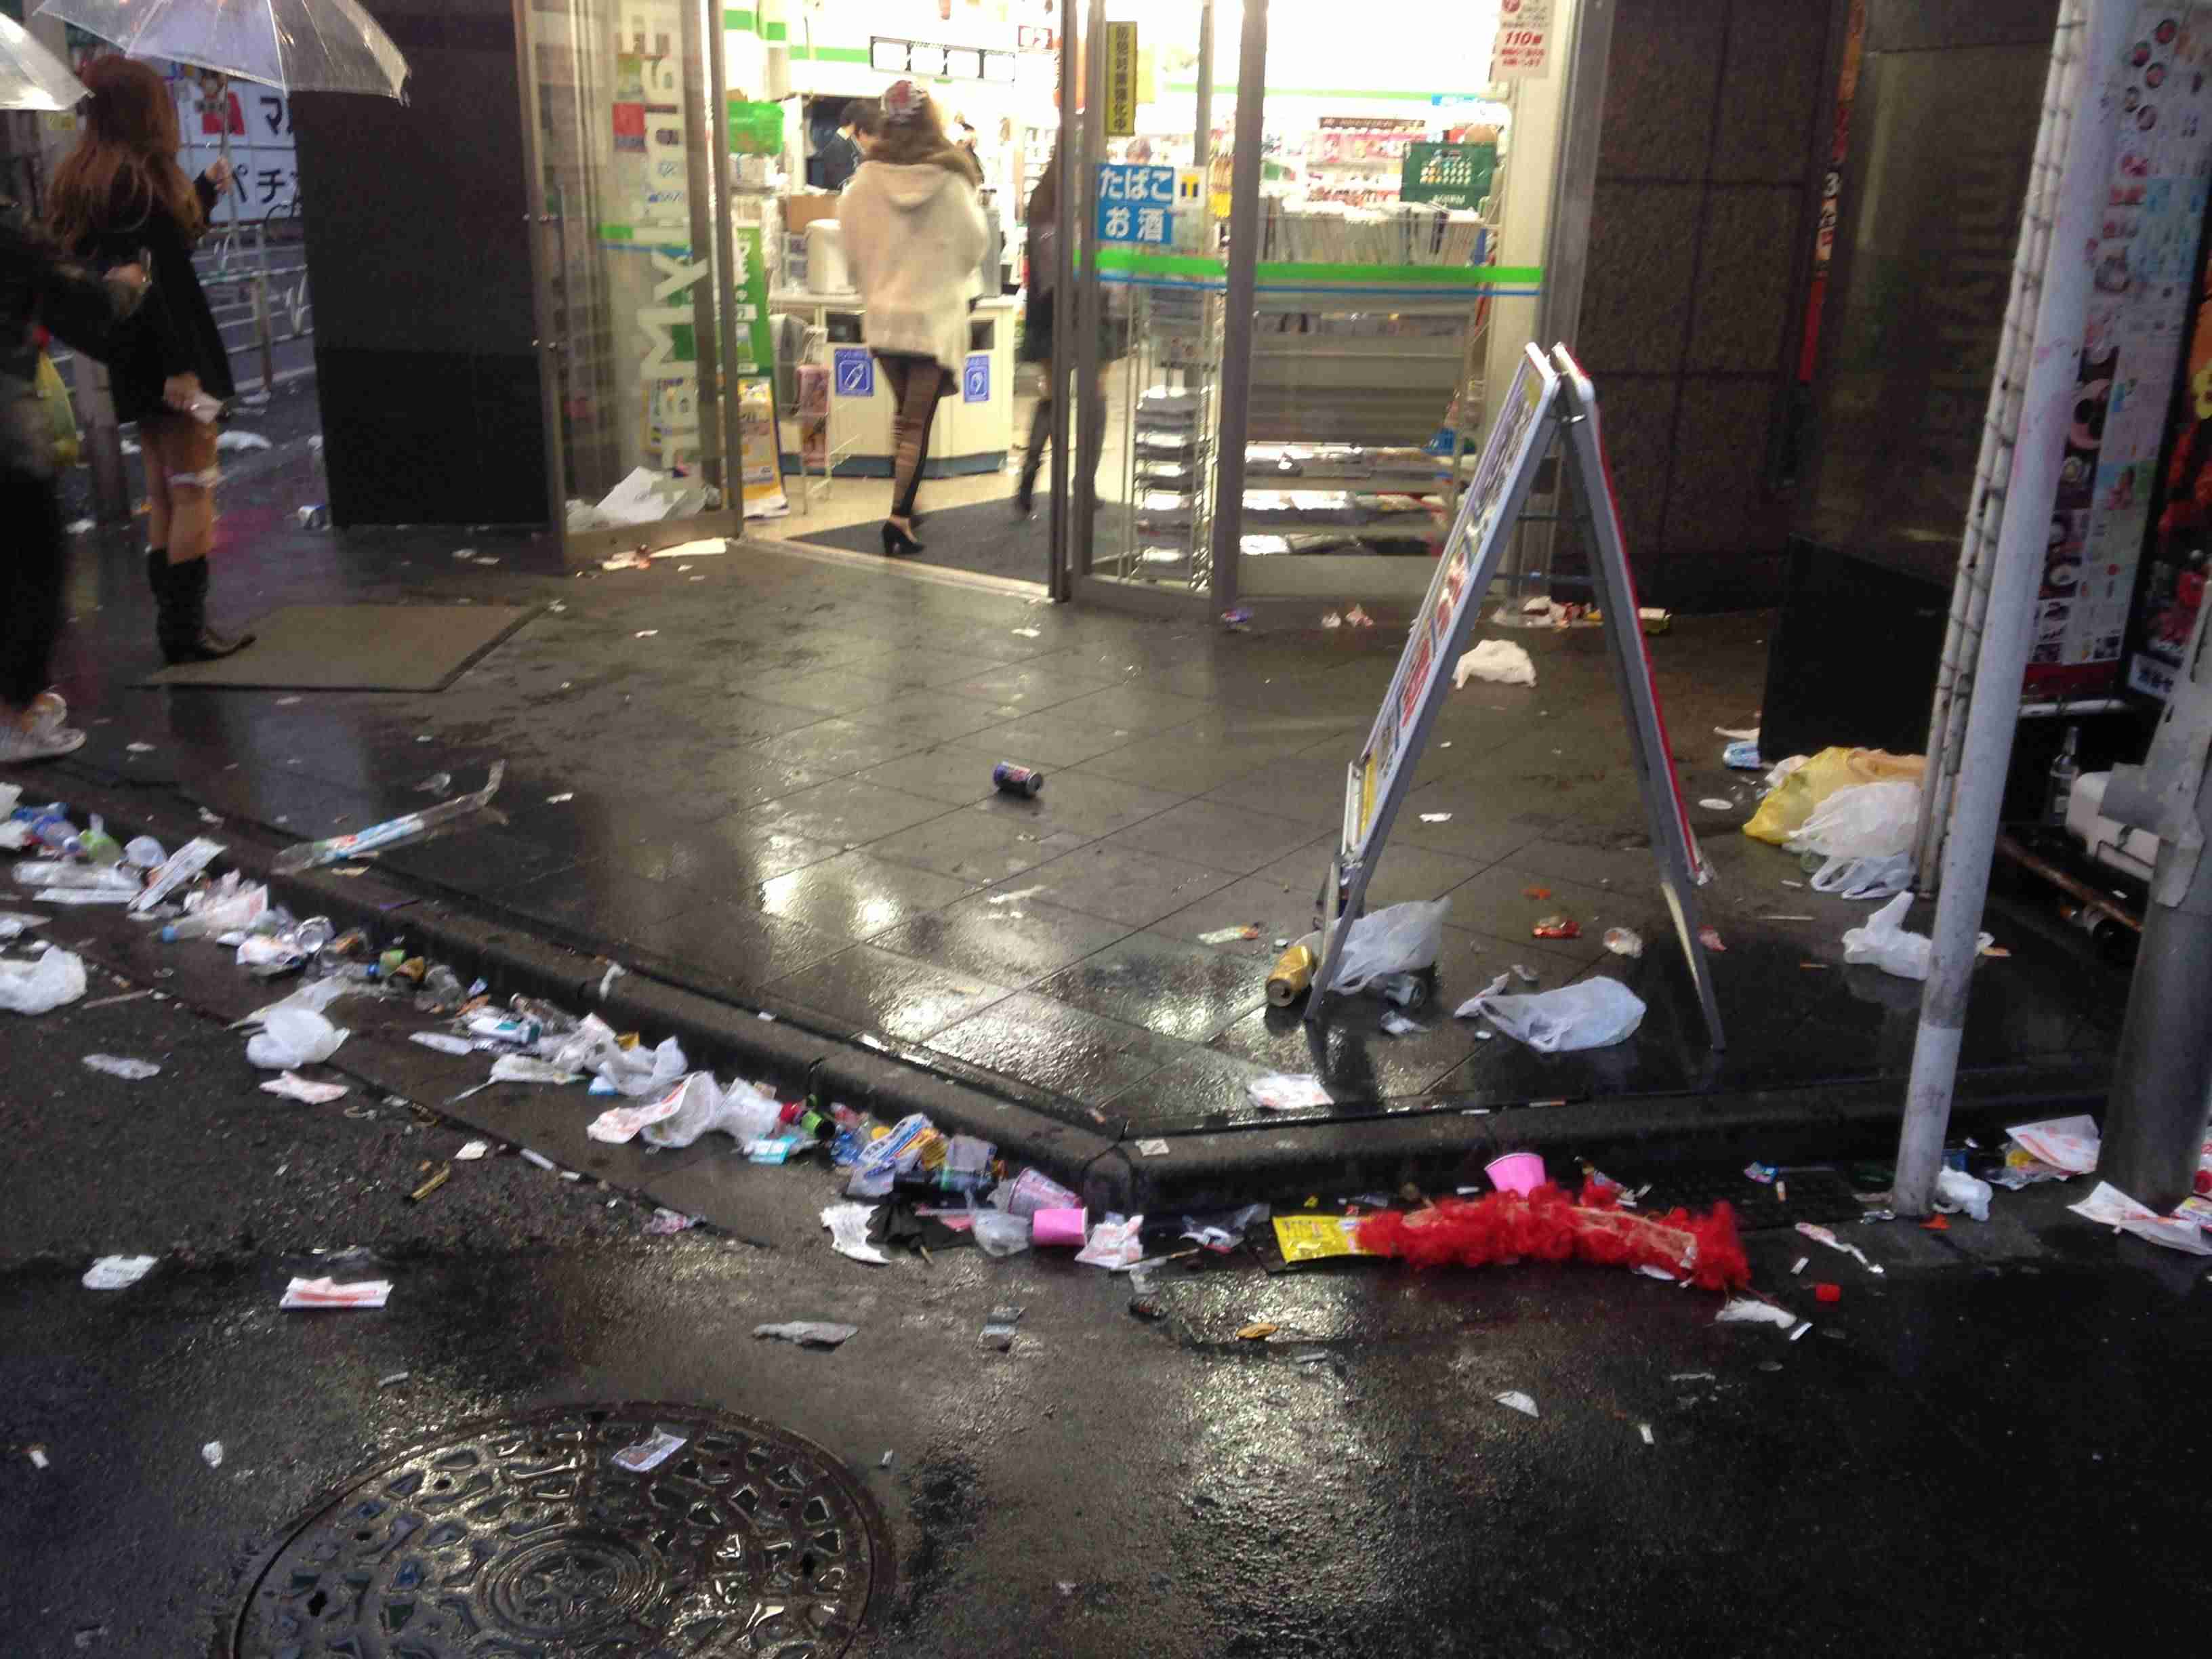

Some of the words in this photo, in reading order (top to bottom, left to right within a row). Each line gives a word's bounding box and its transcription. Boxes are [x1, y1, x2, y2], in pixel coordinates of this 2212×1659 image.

[229, 164, 298, 204] パチ
[1099, 167, 1172, 201] たばこ
[1105, 205, 1165, 239] お酒
